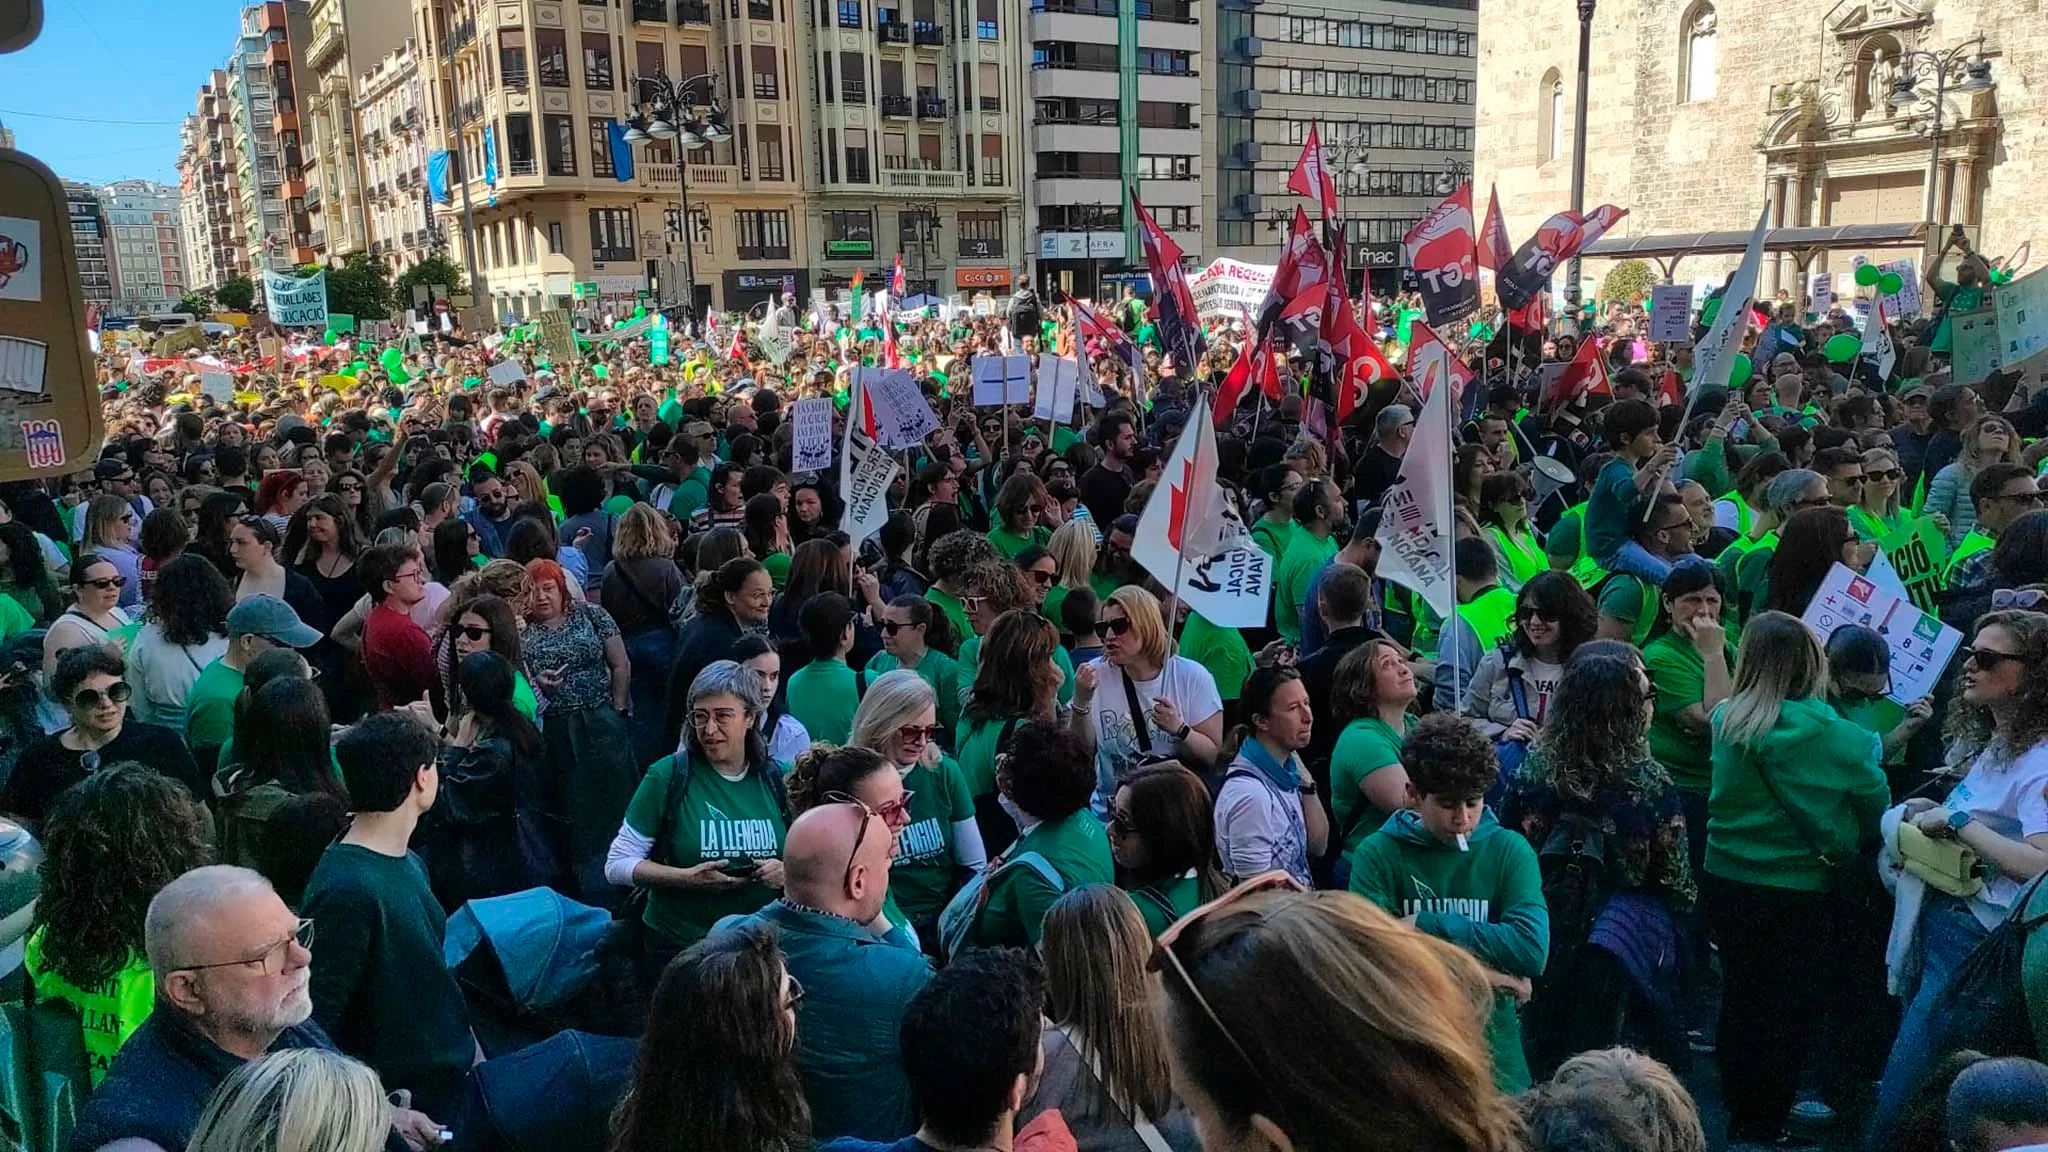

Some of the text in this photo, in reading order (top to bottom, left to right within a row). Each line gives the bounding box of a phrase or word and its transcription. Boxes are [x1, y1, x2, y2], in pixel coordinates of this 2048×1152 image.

[1359, 247, 1394, 264] fnac
[701, 817, 777, 850] LA LLENGUA
[744, 850, 777, 858] TOCA
